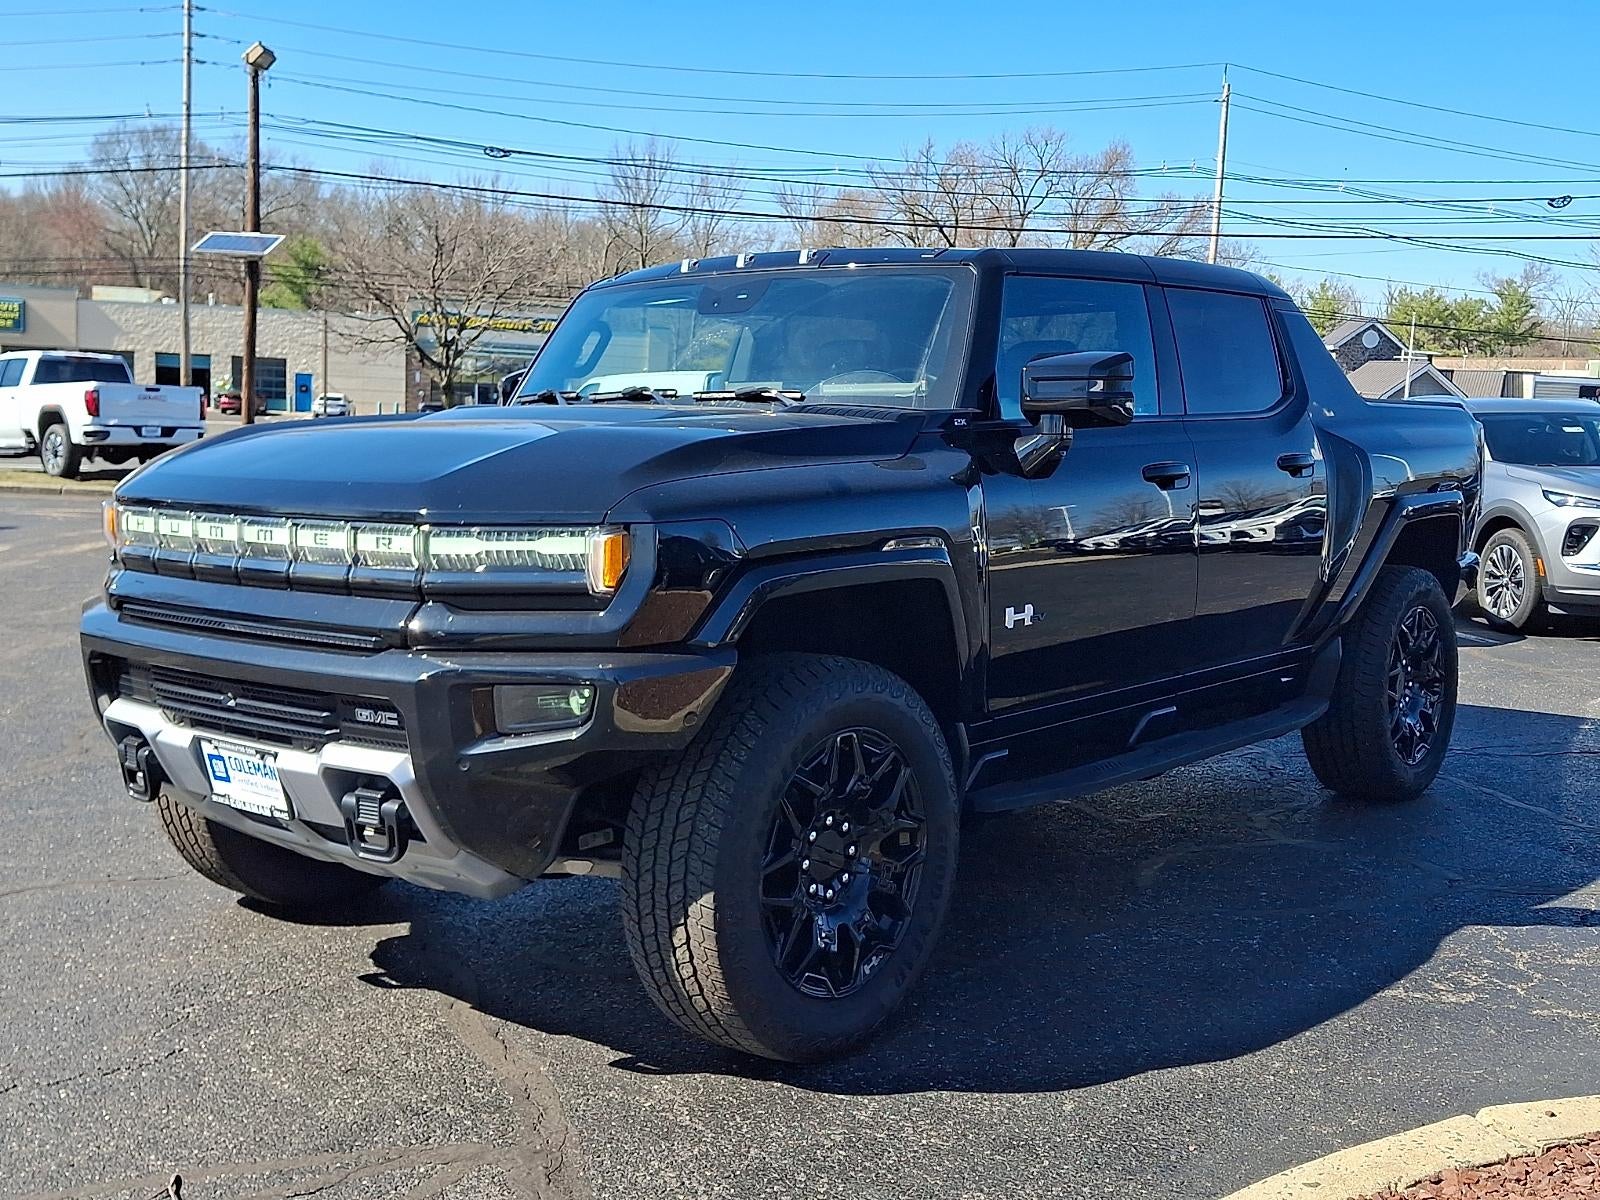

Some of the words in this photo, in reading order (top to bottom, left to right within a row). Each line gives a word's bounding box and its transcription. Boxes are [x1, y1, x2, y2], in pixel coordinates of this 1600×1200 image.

[136, 518, 394, 551] HUMMER
[355, 707, 399, 726] GMC
[228, 755, 278, 781] COLEMAN
